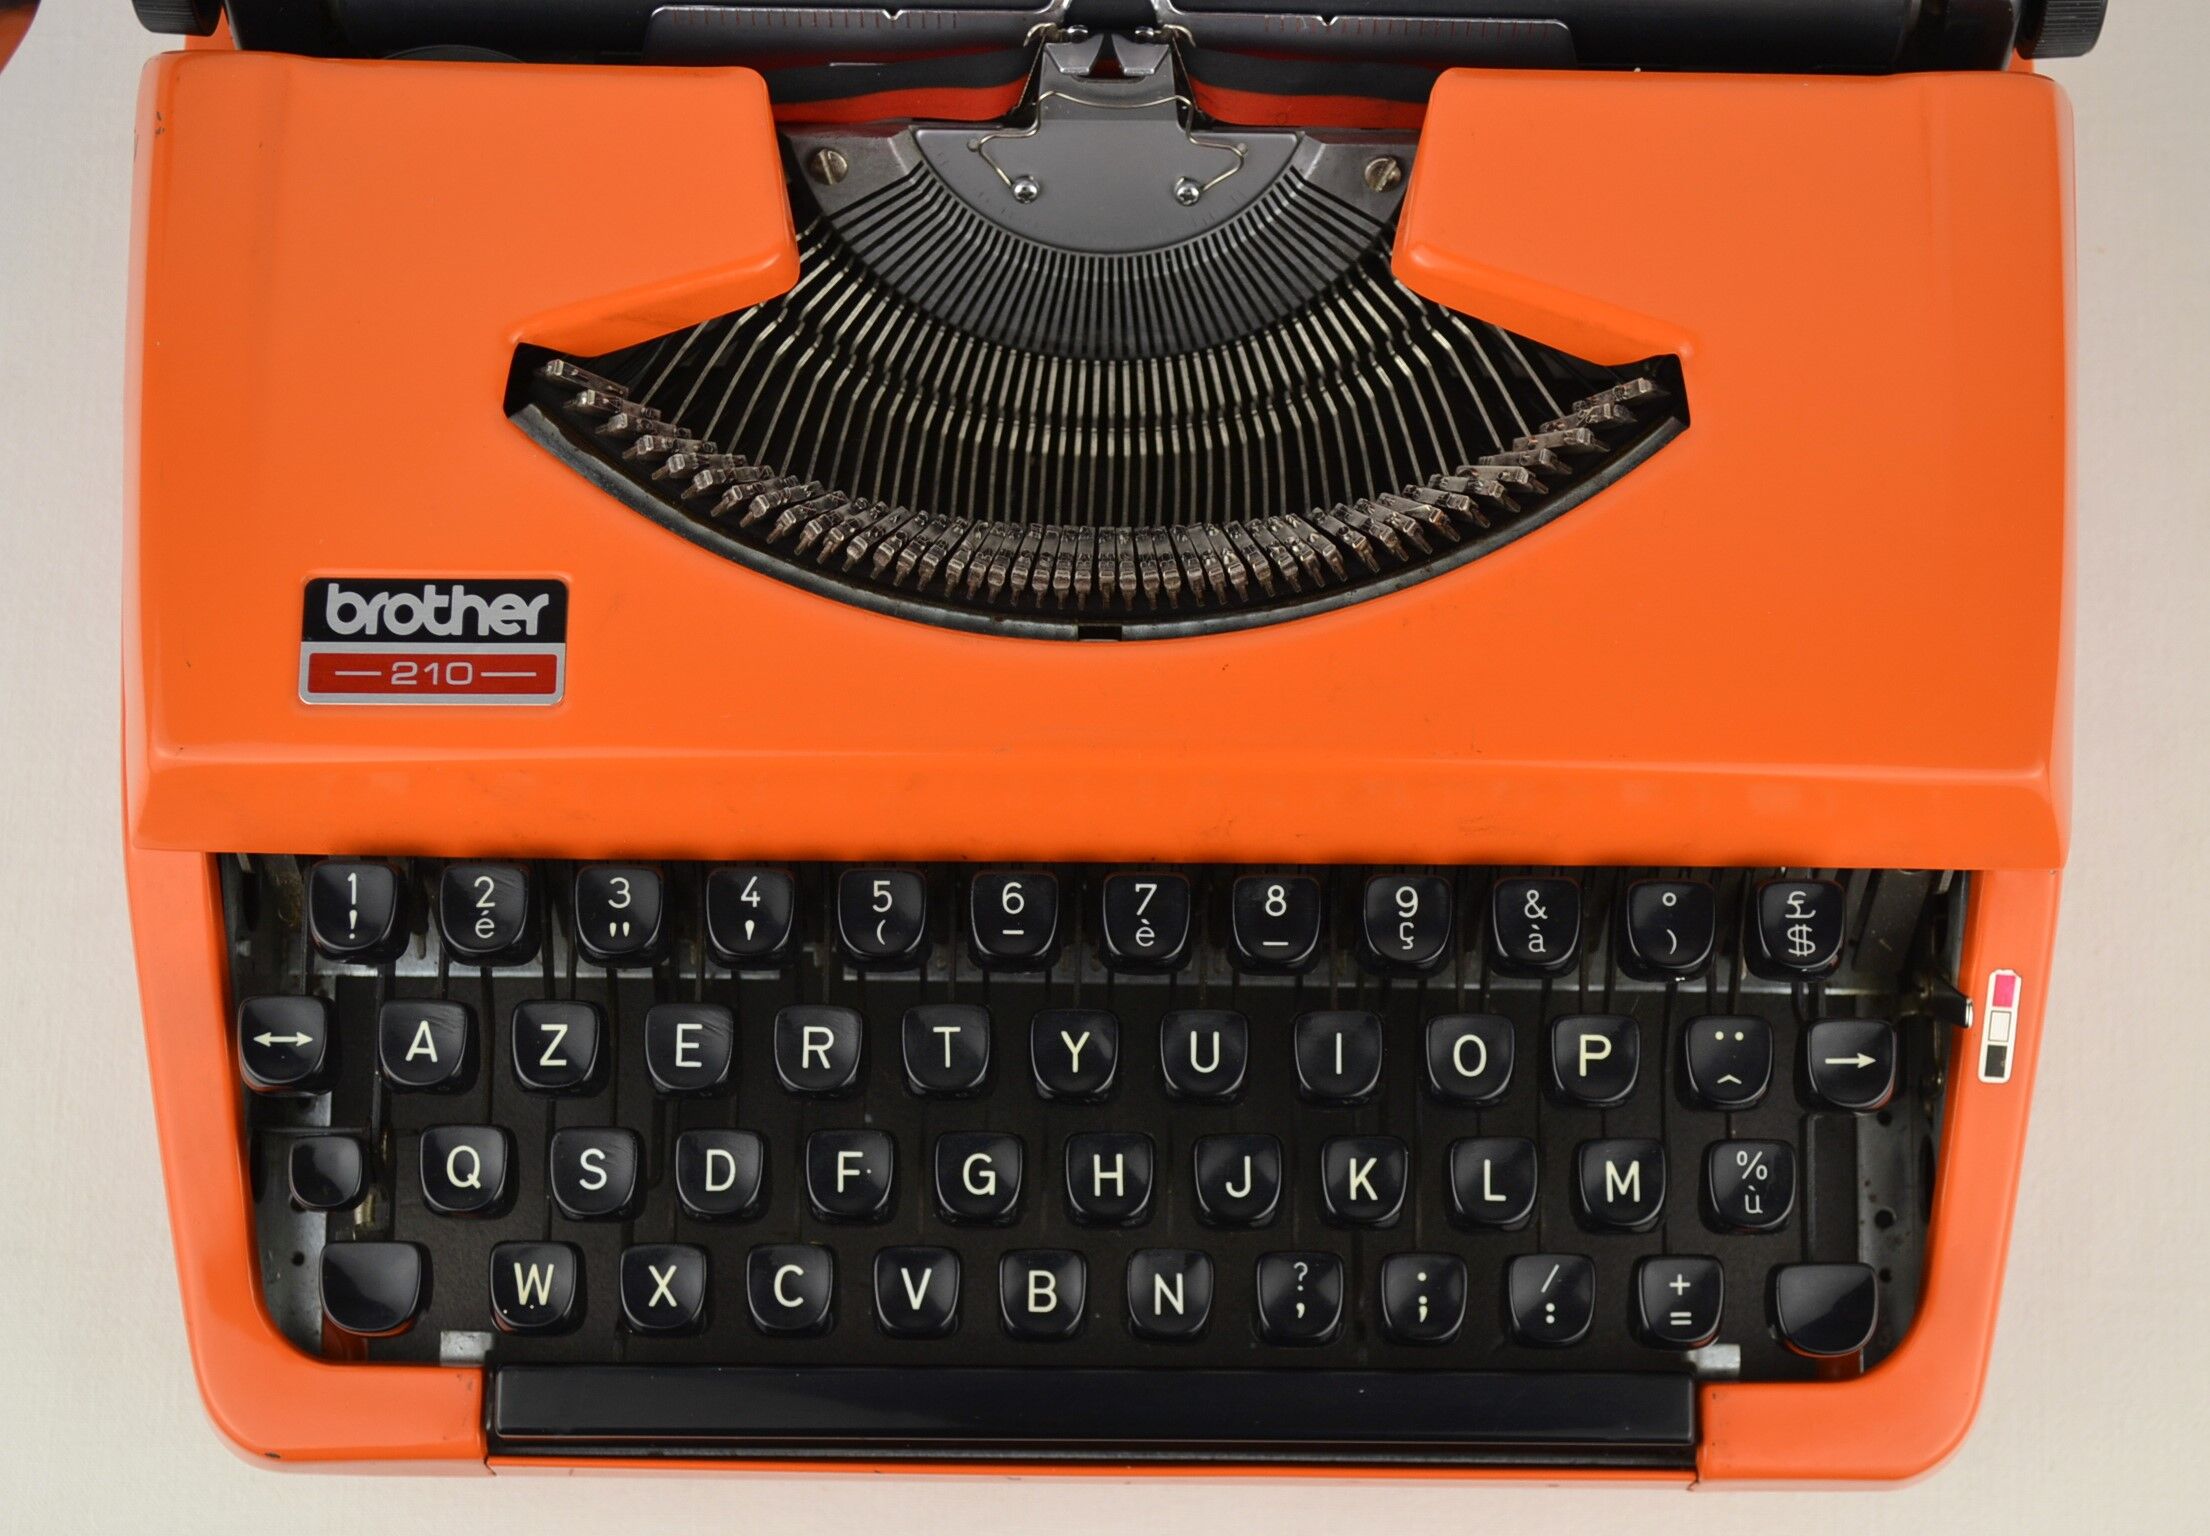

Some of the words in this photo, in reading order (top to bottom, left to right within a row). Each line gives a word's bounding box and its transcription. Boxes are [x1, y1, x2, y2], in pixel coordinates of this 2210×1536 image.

[326, 583, 549, 636] brother
[391, 661, 474, 686] 210
[347, 872, 357, 905] 1
[474, 875, 496, 908] 2
[608, 876, 631, 909] 3
[740, 875, 761, 908] 4
[872, 880, 893, 913] 5
[1002, 881, 1025, 915] 6
[1135, 883, 1158, 916] 7
[1265, 884, 1287, 917] 8
[1395, 885, 1419, 918] 9
[1524, 889, 1548, 920] &
[1785, 890, 1817, 919] £
[349, 909, 358, 940] !
[474, 909, 495, 939] é
[876, 919, 886, 945] (
[1135, 918, 1155, 947] è
[1399, 921, 1415, 950] ç
[1528, 924, 1547, 953] à
[1786, 923, 1816, 957] $
[1666, 928, 1677, 955] )
[405, 1019, 438, 1063] A
[539, 1023, 568, 1066] Z
[675, 1023, 703, 1068] E
[802, 1025, 835, 1069] R
[932, 1026, 962, 1068] T
[1060, 1030, 1090, 1073] Y
[1190, 1030, 1220, 1074] U
[1335, 1032, 1342, 1075] I
[1453, 1034, 1487, 1077] O
[1579, 1033, 1612, 1077] P
[446, 1144, 481, 1189] Q
[579, 1147, 608, 1190] S
[705, 1148, 736, 1192] D
[837, 1150, 864, 1193] F
[962, 1152, 996, 1196] G
[1093, 1153, 1124, 1197] H
[1225, 1155, 1252, 1198] J
[1349, 1157, 1378, 1201] K
[1483, 1158, 1507, 1202] L
[1605, 1160, 1641, 1203] M
[1736, 1150, 1768, 1180] %
[1744, 1185, 1764, 1214] ù
[513, 1262, 555, 1306] W
[648, 1264, 678, 1307] X
[773, 1264, 805, 1308] C
[900, 1267, 932, 1310] V
[1028, 1269, 1058, 1313] B
[1154, 1272, 1184, 1315] N
[1293, 1261, 1308, 1292] ?
[1540, 1263, 1560, 1294] /
[1669, 1273, 1691, 1296] +
[1418, 1295, 1428, 1323] ;
[1545, 1302, 1556, 1324] :
[1669, 1311, 1692, 1326] =
